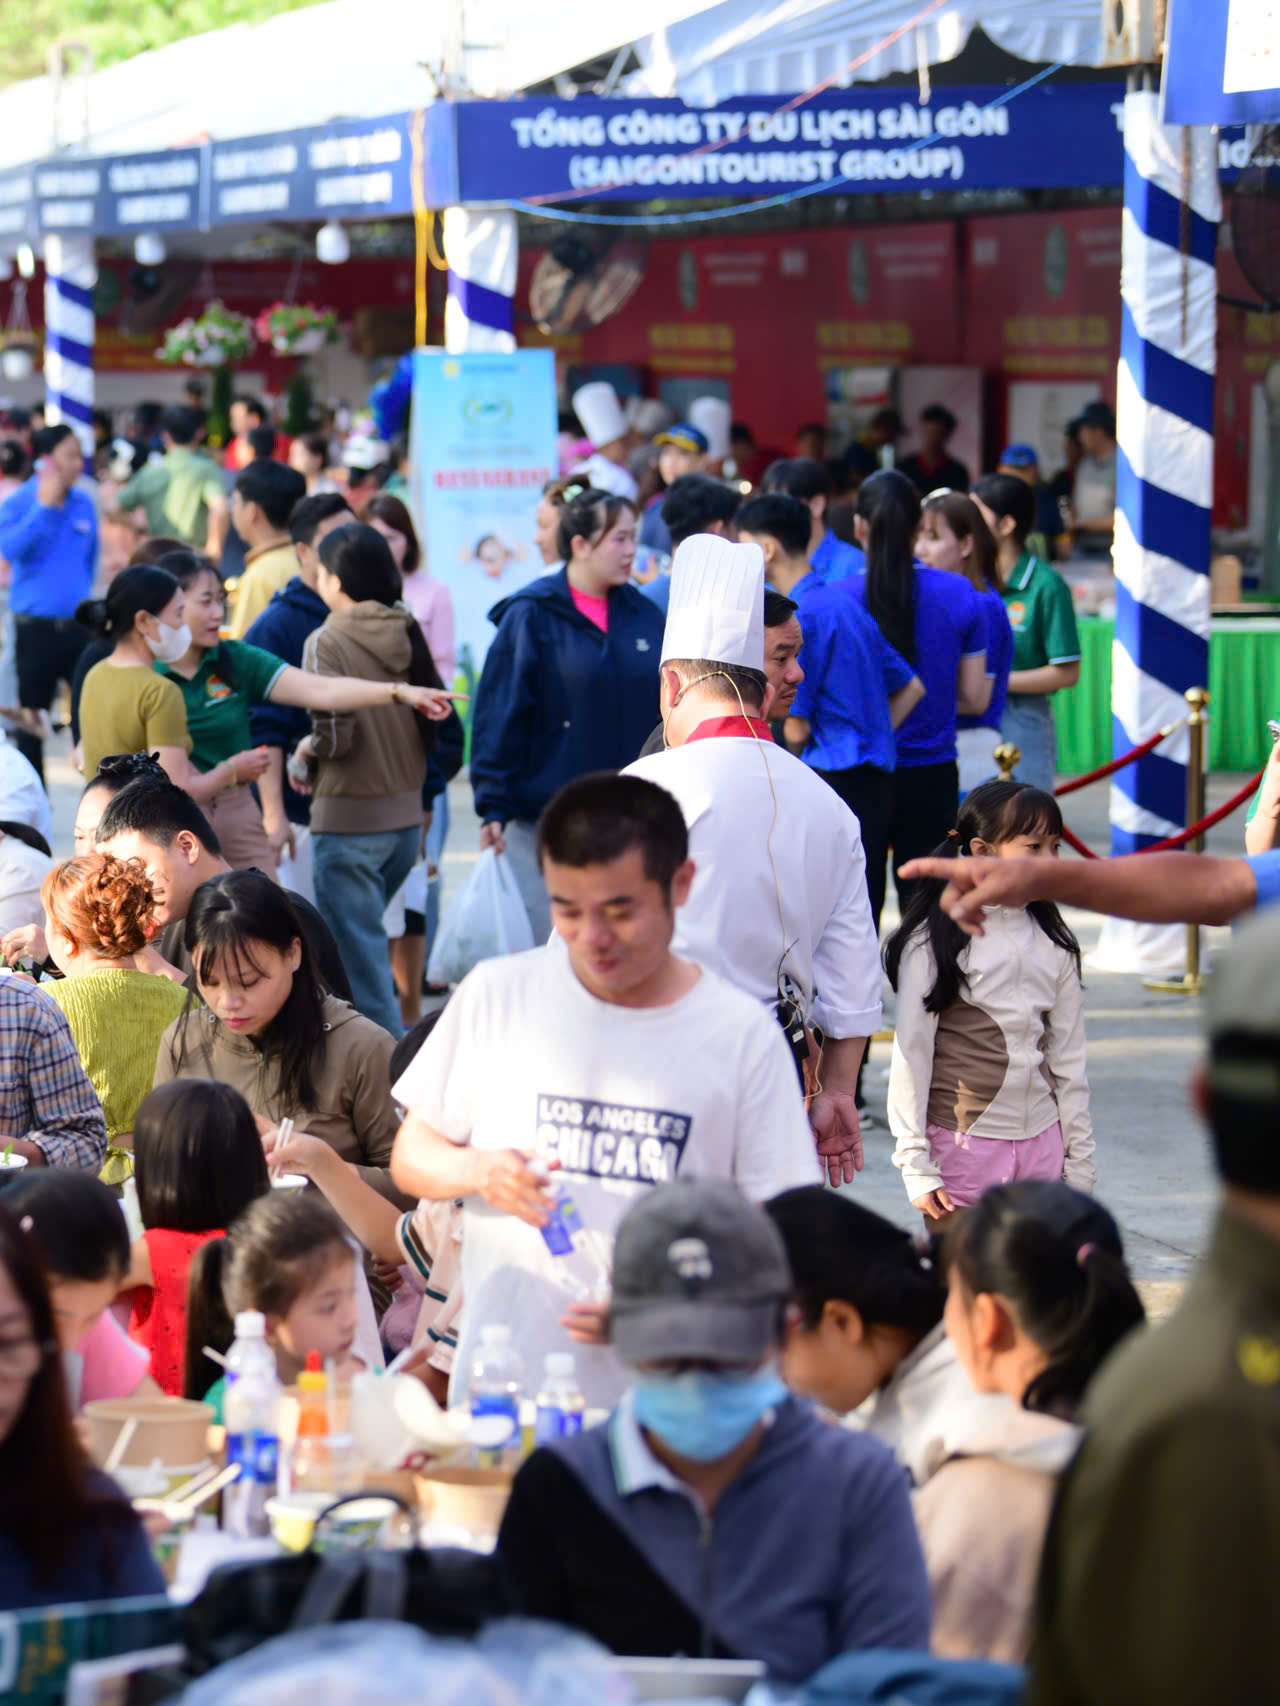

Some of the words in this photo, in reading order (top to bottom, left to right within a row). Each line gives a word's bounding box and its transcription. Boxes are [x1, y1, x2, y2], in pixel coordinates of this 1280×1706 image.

[608, 109, 701, 146] CÔNG
[702, 111, 747, 142] TY
[748, 111, 798, 142] DU
[800, 108, 875, 148] LỊCH
[877, 102, 932, 140] SÀI
[934, 101, 1009, 137] GÒN
[569, 149, 838, 188] (SAIGONTOURIST
[840, 146, 964, 181] GROUP)
[538, 1097, 584, 1125] LOS
[585, 1105, 687, 1140] ANGELES
